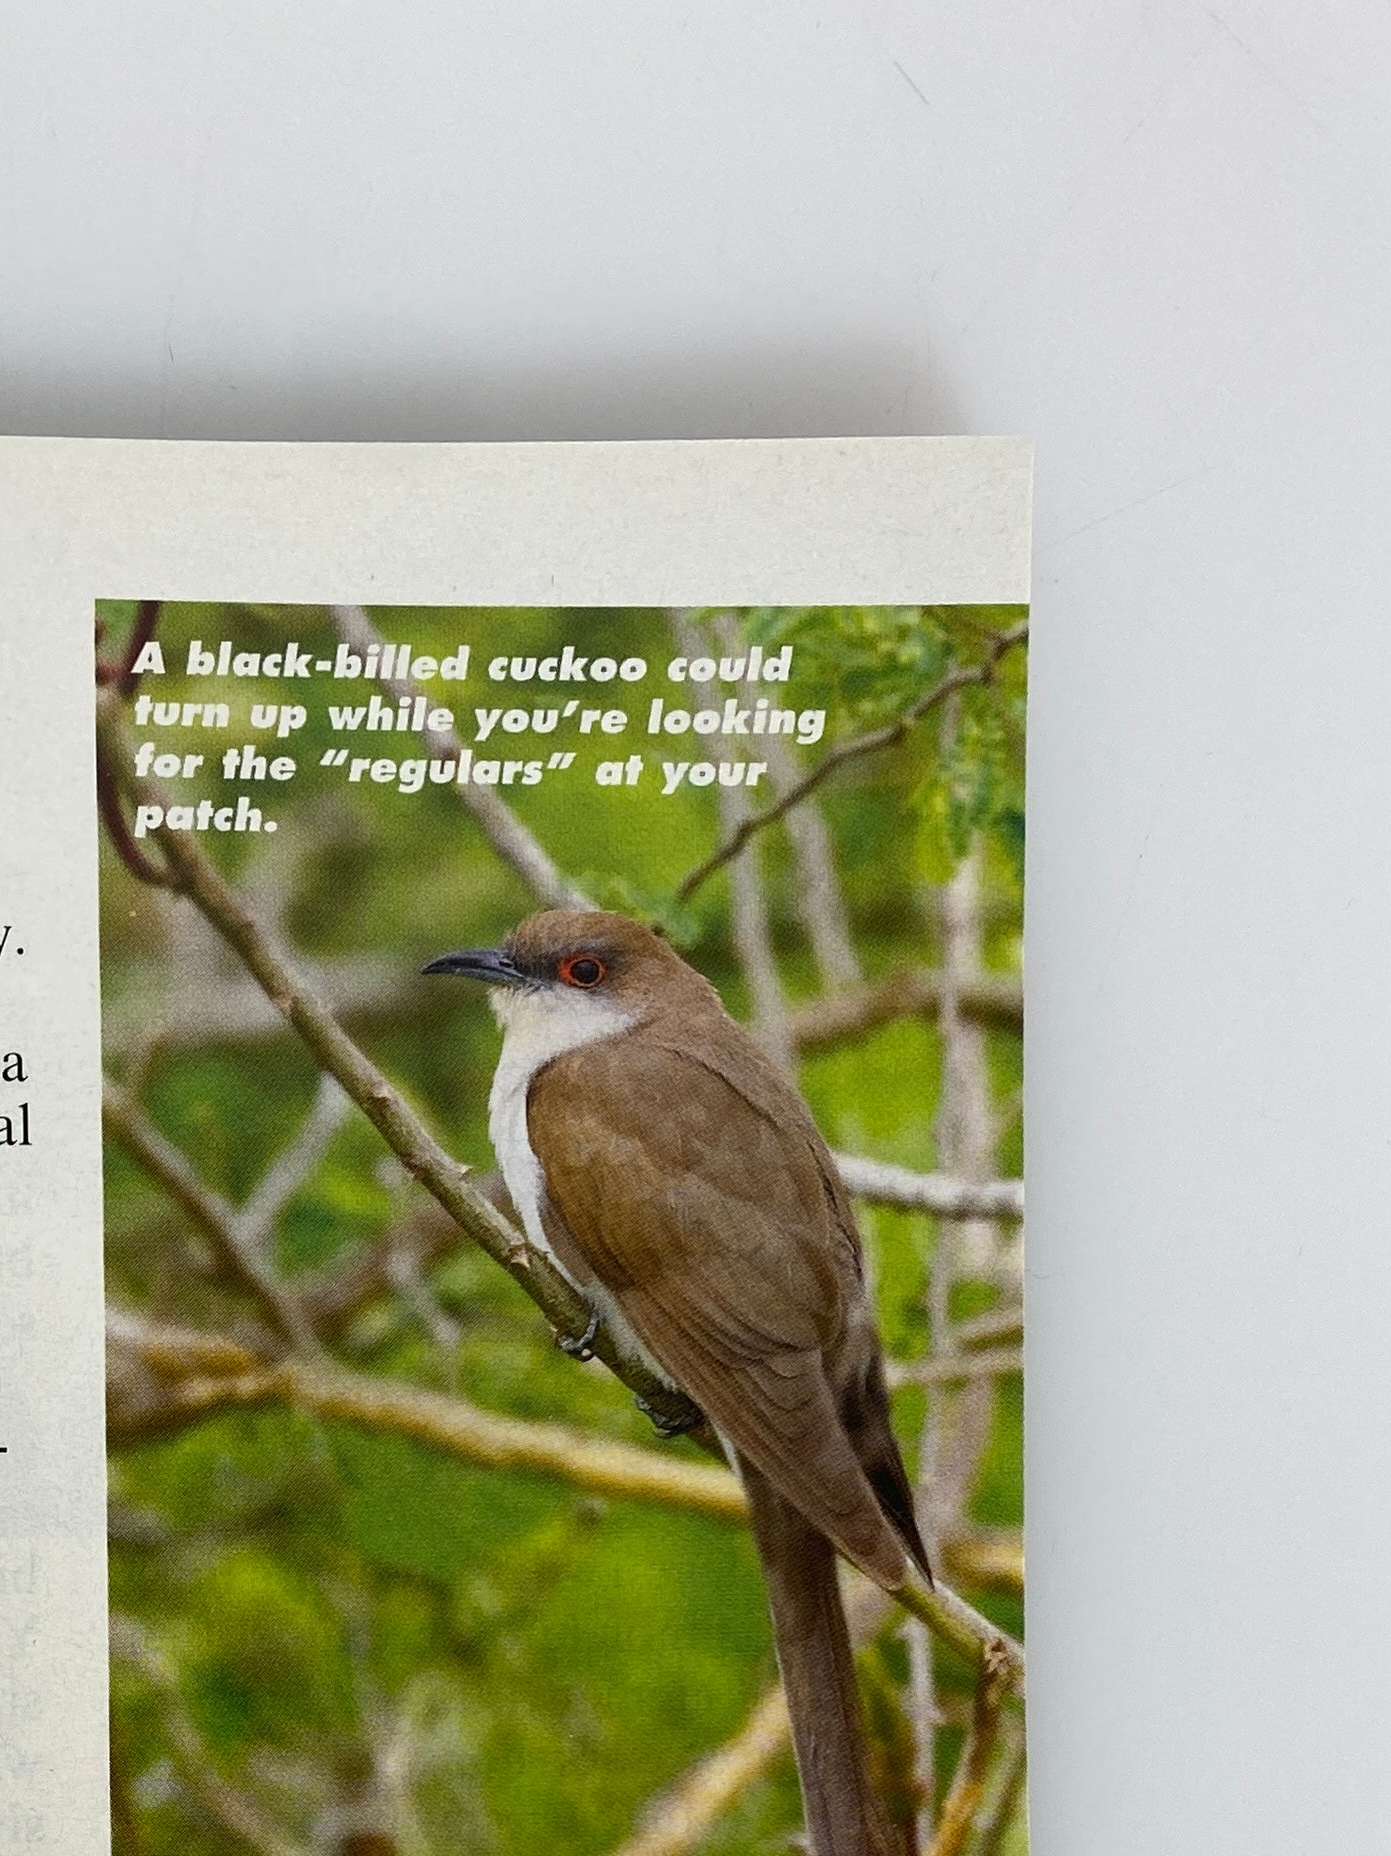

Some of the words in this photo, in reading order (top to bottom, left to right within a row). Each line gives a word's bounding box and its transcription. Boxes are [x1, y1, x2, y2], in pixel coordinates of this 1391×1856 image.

[131, 642, 165, 673] A
[187, 641, 469, 680] black-billed
[488, 646, 646, 681] cuckoo
[668, 646, 792, 682] could
[135, 695, 230, 727] turn
[251, 705, 306, 737] up
[329, 696, 454, 734] while
[648, 698, 825, 744] looking
[134, 742, 204, 778] for
[223, 745, 296, 780] the
[596, 756, 643, 785] at
[663, 762, 767, 794] your
[135, 797, 277, 838] patch.
